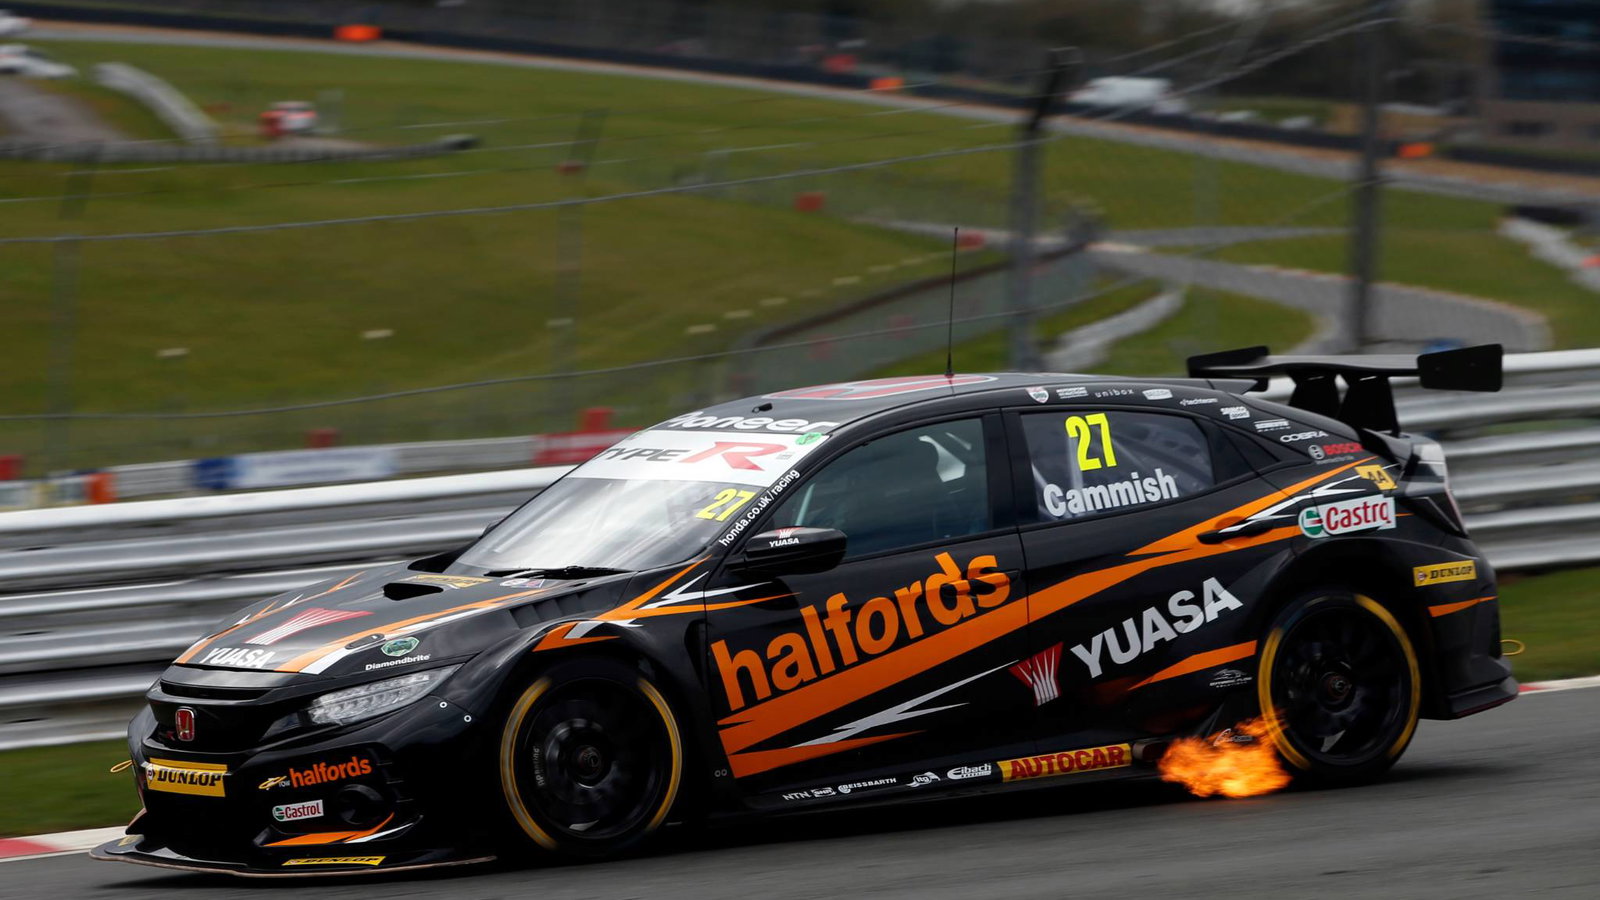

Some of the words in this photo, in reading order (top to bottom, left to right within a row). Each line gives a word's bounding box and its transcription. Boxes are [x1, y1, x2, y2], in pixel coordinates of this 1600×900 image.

[1095, 388, 1134, 399] unibox
[1065, 412, 1118, 471] 27
[1280, 430, 1329, 443] COBRA
[604, 448, 691, 462] TYPE
[677, 441, 788, 472] R
[695, 488, 757, 522] 27
[1043, 468, 1179, 517] Cammish
[718, 469, 801, 547] honda.co.uk/racing
[1326, 501, 1391, 531] Castro
[769, 537, 800, 548] YUASA
[1430, 565, 1472, 580] DUNLOP
[711, 551, 1010, 711] halfords
[1070, 576, 1243, 679] YUASA
[199, 647, 276, 669] YUASA
[364, 654, 430, 671] Diamondbrite
[289, 756, 372, 788] halfords
[947, 762, 992, 780] Eibach
[1010, 746, 1125, 780] AUTOCAR
[157, 768, 222, 787] DUNLOP
[782, 791, 812, 801] NTN
[285, 803, 321, 819] Castrol
